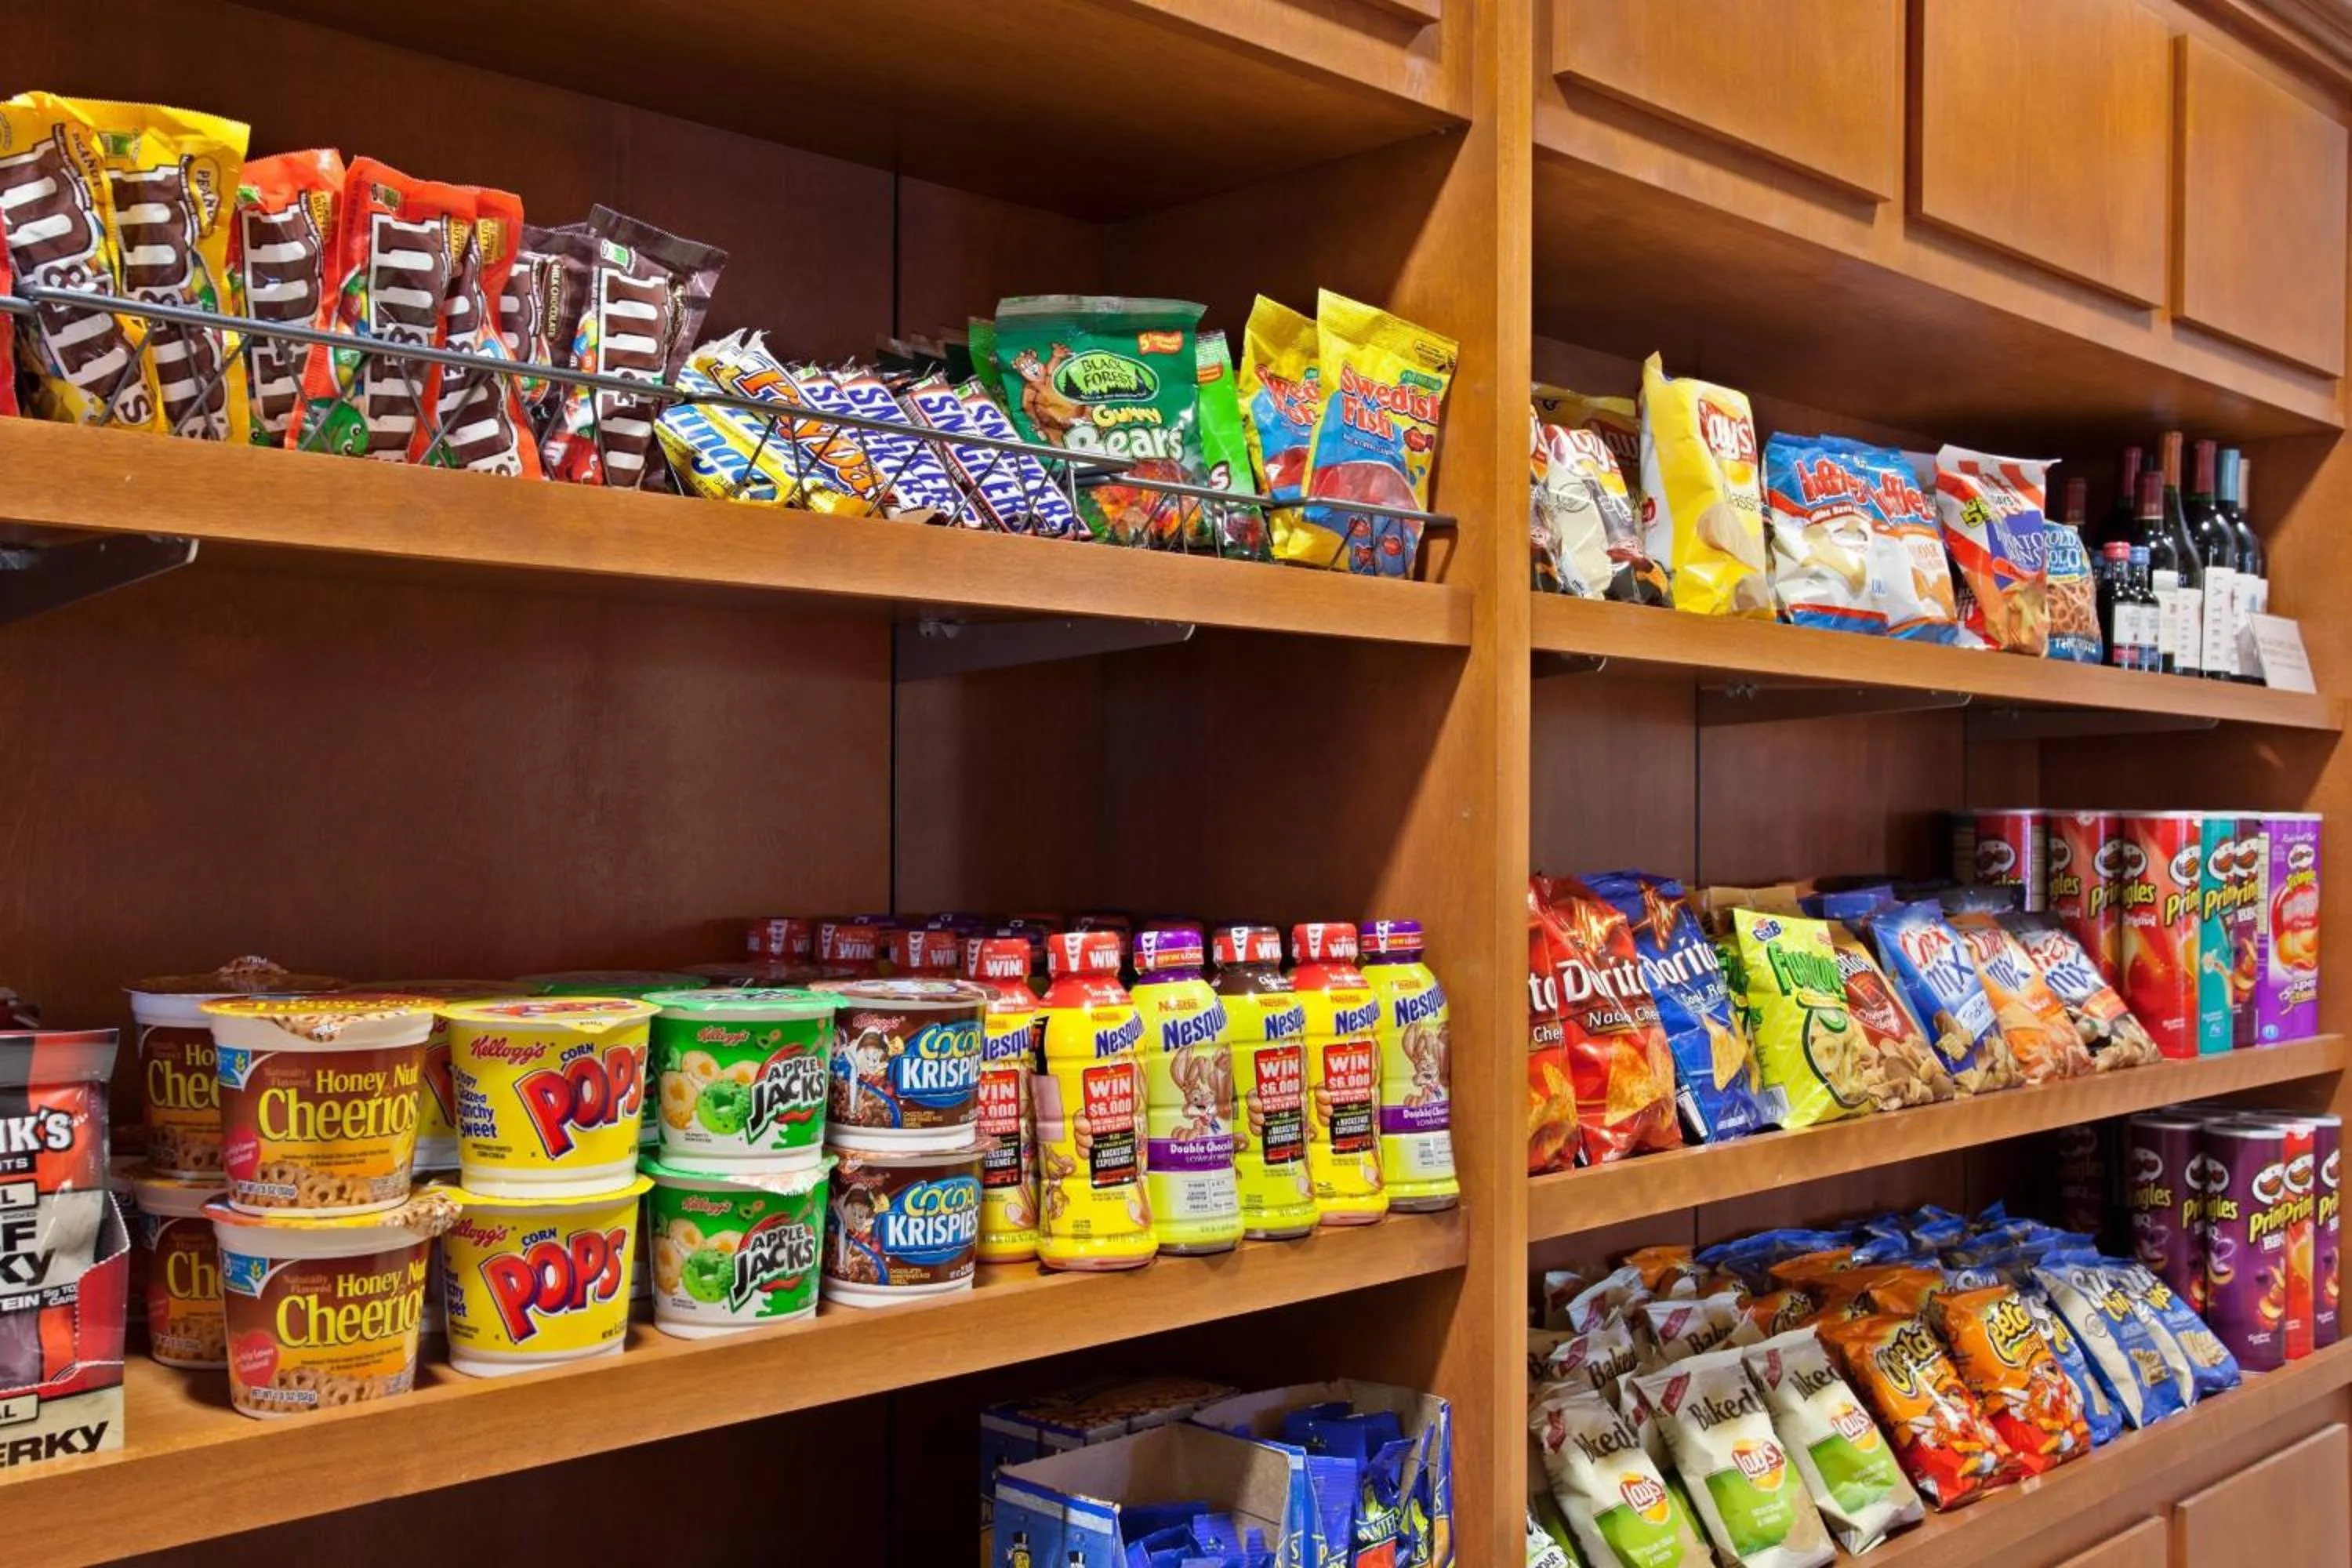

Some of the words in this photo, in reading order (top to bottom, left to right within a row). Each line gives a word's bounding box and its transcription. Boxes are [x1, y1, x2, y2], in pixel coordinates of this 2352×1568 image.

[1064, 426, 1184, 467] Bears
[1701, 401, 1755, 461] ay's
[2046, 548, 2081, 568] OLD
[1162, 999, 1228, 1053] Nesqui
[470, 1035, 548, 1065] Kellogg's
[560, 1044, 595, 1061] CORN
[1328, 1053, 1370, 1073] WIN
[316, 1069, 387, 1098] Honey
[394, 1062, 419, 1087] Nut
[768, 1058, 818, 1083] APPLE
[1259, 1058, 1299, 1080] WIN
[513, 1044, 648, 1161] POPS
[1089, 1077, 1131, 1098] WIN
[258, 1086, 419, 1143] Cheerios
[748, 1074, 825, 1142] JACKS
[1171, 1142, 1205, 1155] Double
[904, 1184, 975, 1218] COCOA
[521, 1227, 558, 1247] CORN
[751, 1224, 805, 1251] APPLE
[887, 1205, 979, 1247] KRISPIES
[337, 1269, 402, 1299] Honey
[478, 1229, 627, 1345] POPS
[730, 1239, 815, 1308] JACKS
[0, 1420, 109, 1468] ERKY
